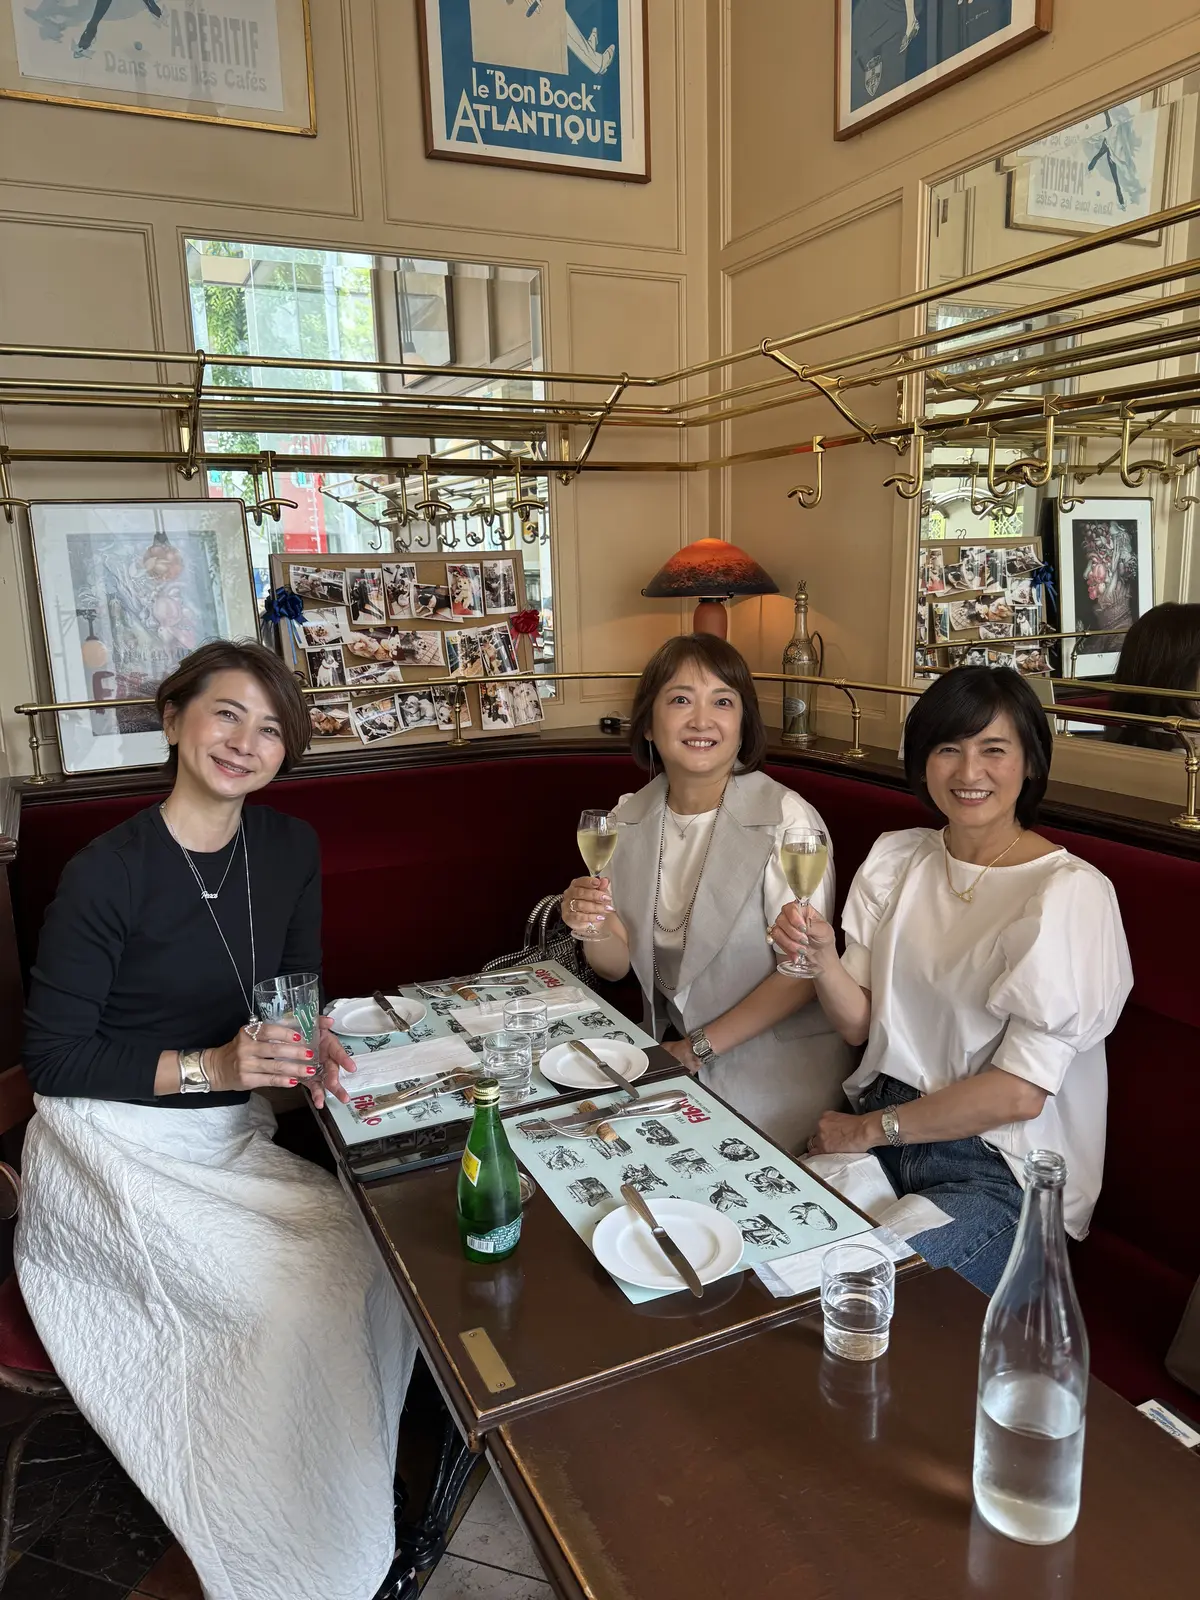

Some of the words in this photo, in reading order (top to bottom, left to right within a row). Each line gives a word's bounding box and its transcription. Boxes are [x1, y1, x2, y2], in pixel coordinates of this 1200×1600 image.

[171, 8, 259, 69] APÉRITIF
[104, 50, 148, 78] Dans
[153, 61, 188, 82] tous
[194, 63, 218, 88] les
[225, 69, 267, 92] Cafés
[471, 66, 489, 99] le
[451, 88, 618, 146] ATLANTIQUE
